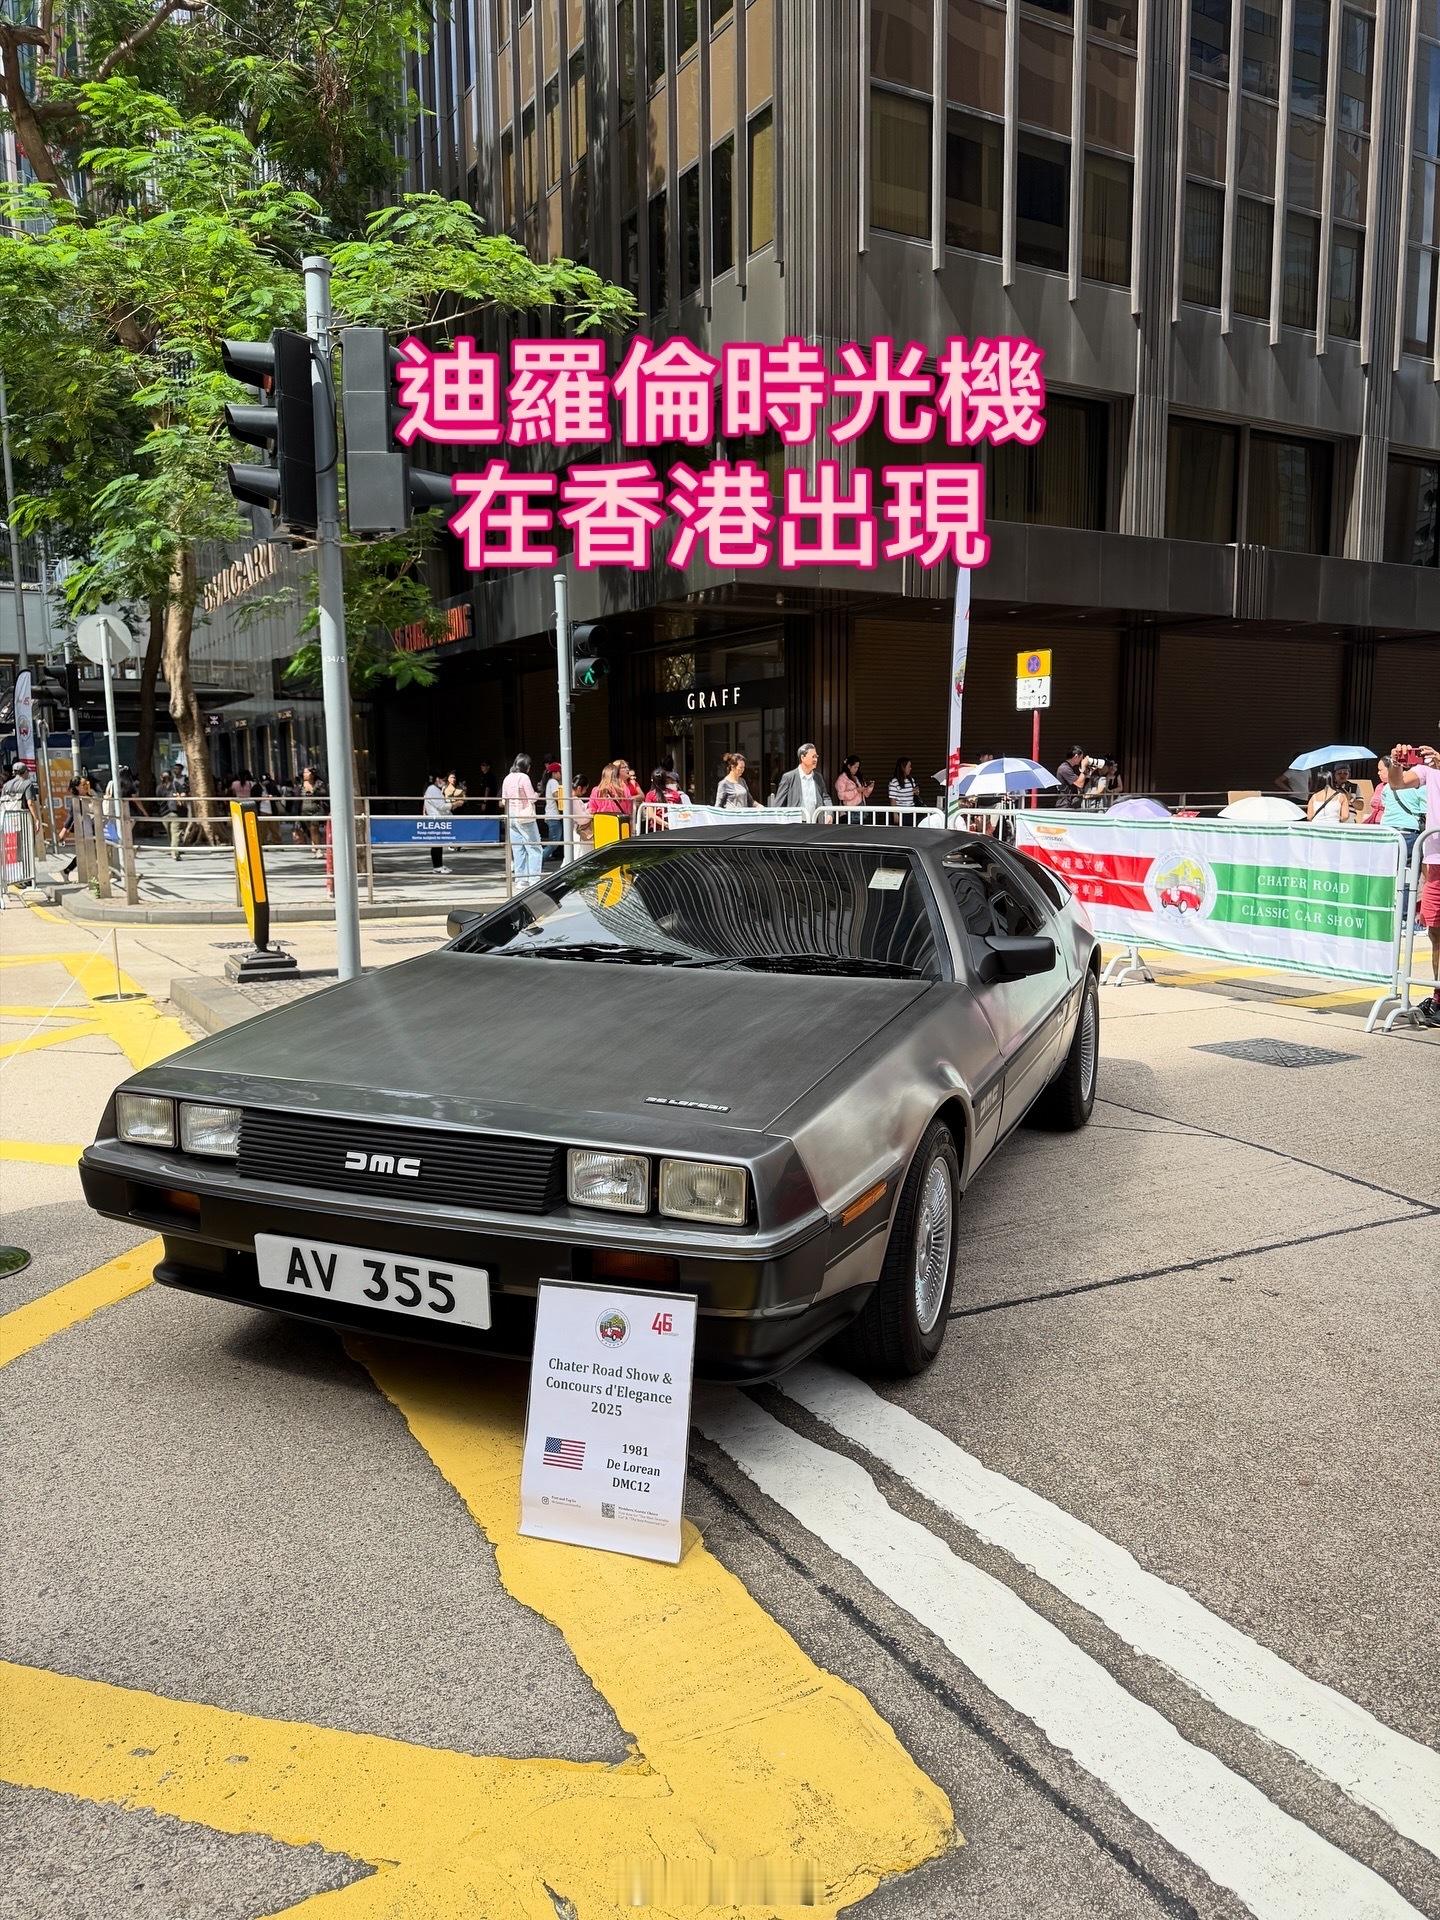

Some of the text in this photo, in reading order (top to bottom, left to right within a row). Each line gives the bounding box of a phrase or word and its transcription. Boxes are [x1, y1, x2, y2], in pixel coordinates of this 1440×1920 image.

[687, 687, 741, 710] GRAFF
[1037, 694, 1048, 705] 12
[416, 821, 452, 830] PLEASE
[1257, 875, 1350, 894] CHATER ROAD
[1241, 905, 1364, 929] CLASSIC CAR SHOW
[344, 1151, 421, 1177] DMC
[286, 1246, 456, 1314] AV 355
[651, 1312, 673, 1336] 46
[548, 1357, 673, 1385] Chater Road Show &
[546, 1376, 672, 1404] Concours d'Elegance
[591, 1401, 622, 1417] 2025
[622, 1443, 649, 1457] 1981
[606, 1458, 661, 1477] De Lorean
[612, 1477, 650, 1493] DMC12
